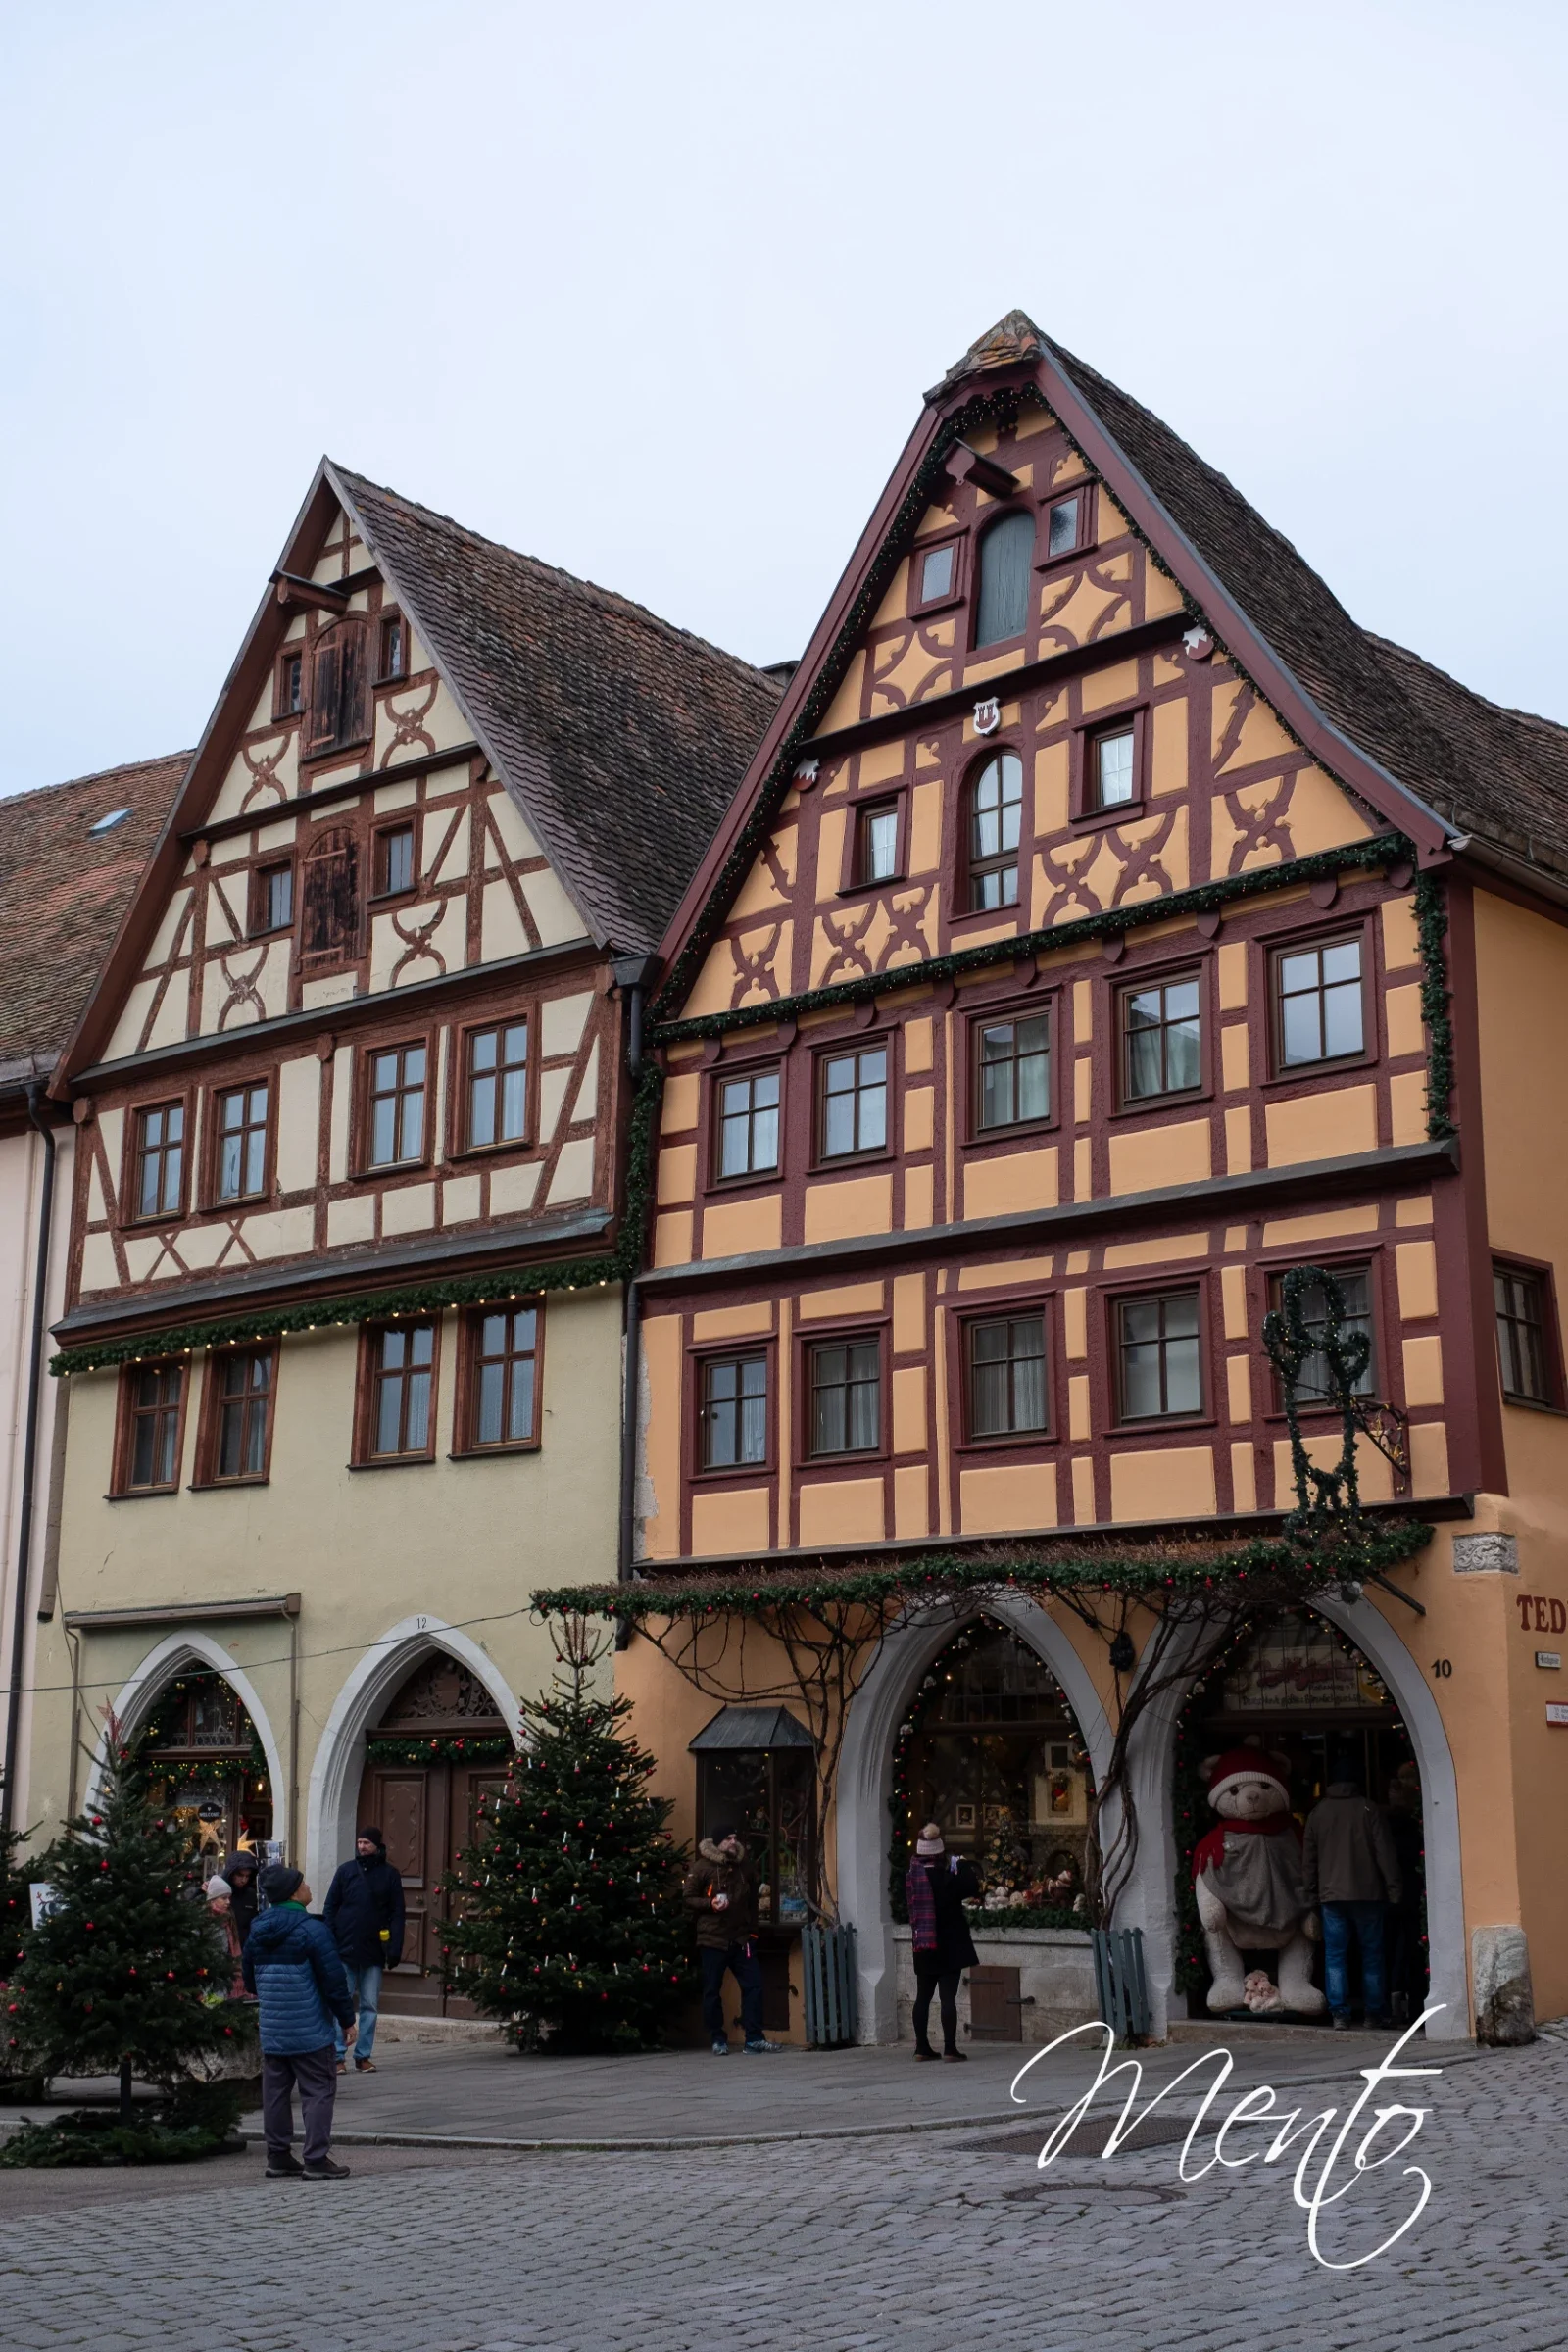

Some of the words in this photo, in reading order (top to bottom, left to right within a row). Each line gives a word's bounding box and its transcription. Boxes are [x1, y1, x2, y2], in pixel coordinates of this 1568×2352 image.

[416, 1617, 427, 1630] 12
[1516, 1594, 1568, 1634] TED
[1431, 1659, 1452, 1679] 10
